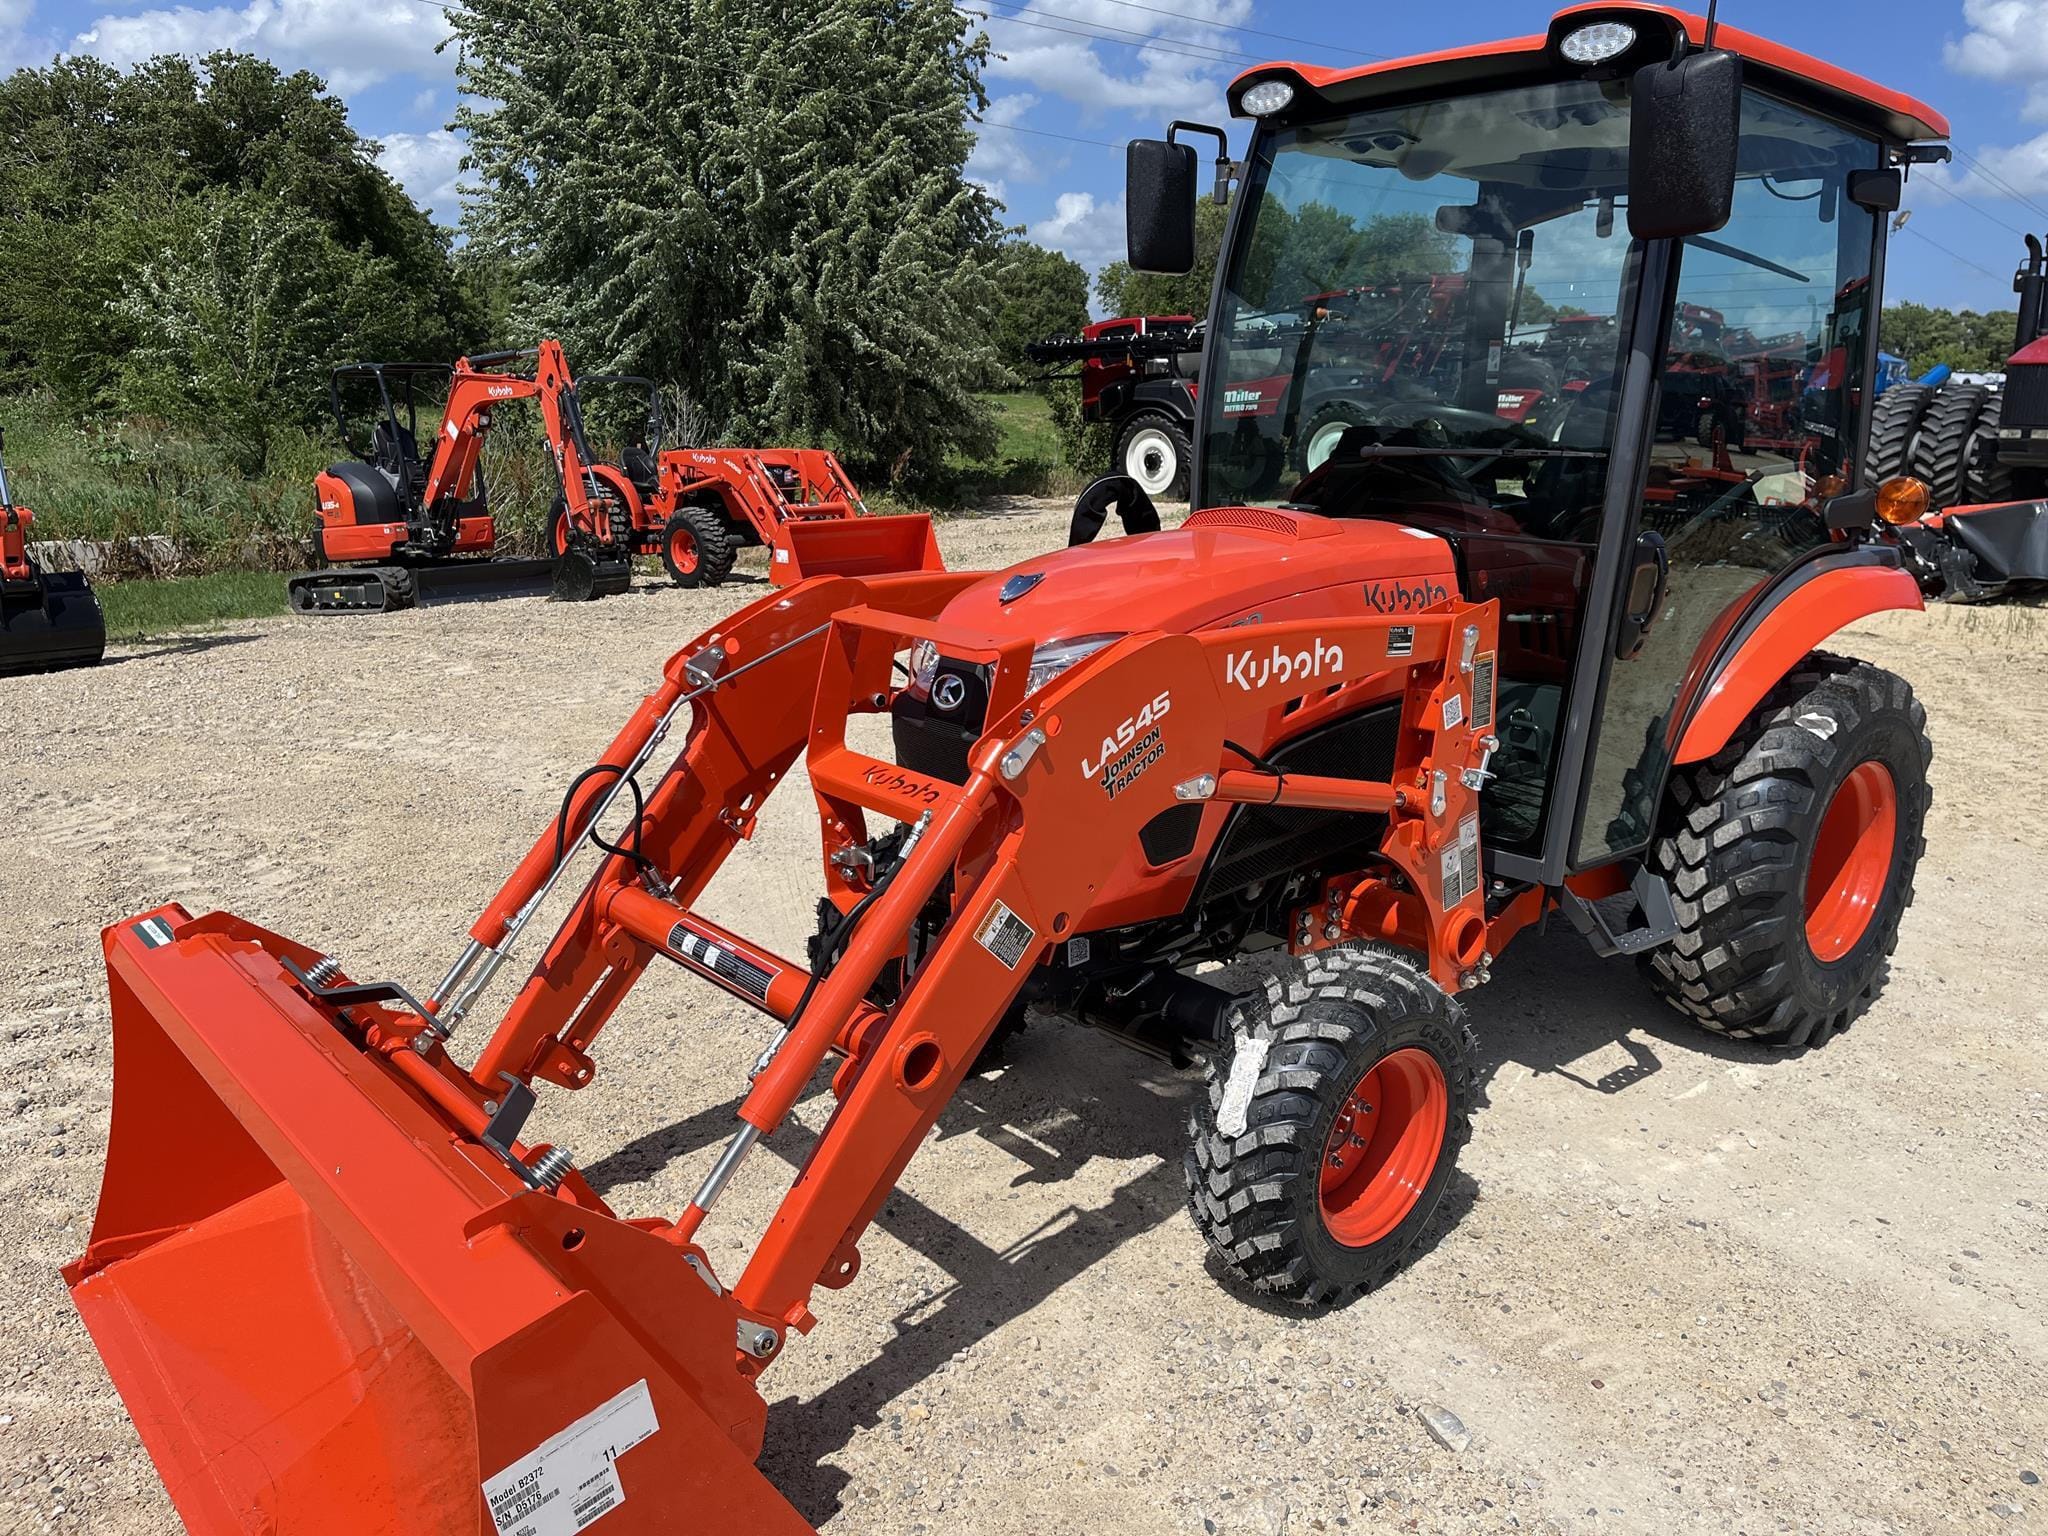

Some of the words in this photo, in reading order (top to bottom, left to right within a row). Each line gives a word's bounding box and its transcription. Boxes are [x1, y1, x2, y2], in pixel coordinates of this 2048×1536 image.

[487, 385, 513, 397] Kubota
[1224, 389, 1262, 403] Miller
[1363, 579, 1447, 613] Kubota
[1226, 637, 1343, 691] Kubota
[1081, 690, 1171, 779] LA545
[1100, 726, 1161, 786] JOHNSON
[1105, 743, 1165, 800] TRACTOR
[862, 765, 940, 803] Kubota
[602, 1445, 617, 1462] 11
[490, 1484, 516, 1507] Model
[518, 1466, 544, 1489] B2372
[495, 1511, 511, 1526] S/N
[515, 1490, 542, 1513] D5176
